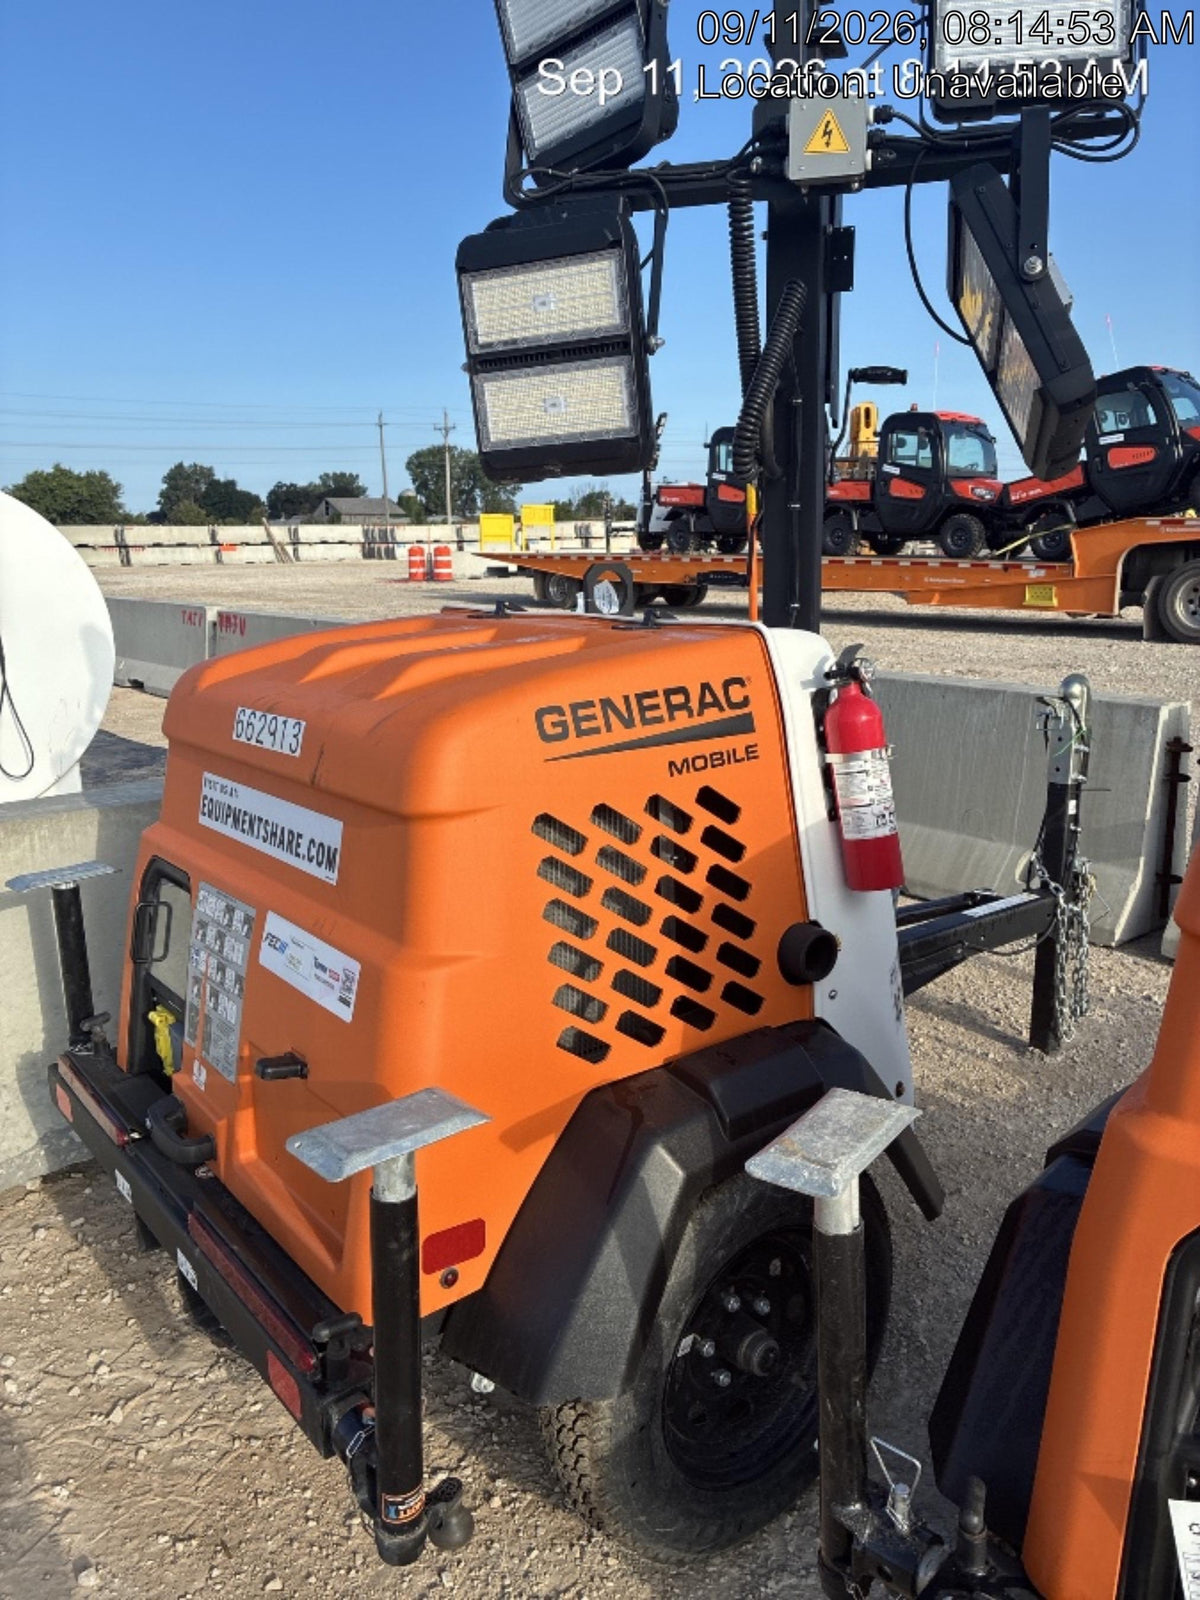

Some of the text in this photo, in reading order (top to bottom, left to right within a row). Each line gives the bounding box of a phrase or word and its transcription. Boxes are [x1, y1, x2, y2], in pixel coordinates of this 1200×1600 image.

[236, 708, 302, 755] 662913
[535, 677, 750, 743] GENERAC
[668, 743, 759, 777] MOBILE
[201, 794, 339, 874] EQUIPMENTSHARE.COM
